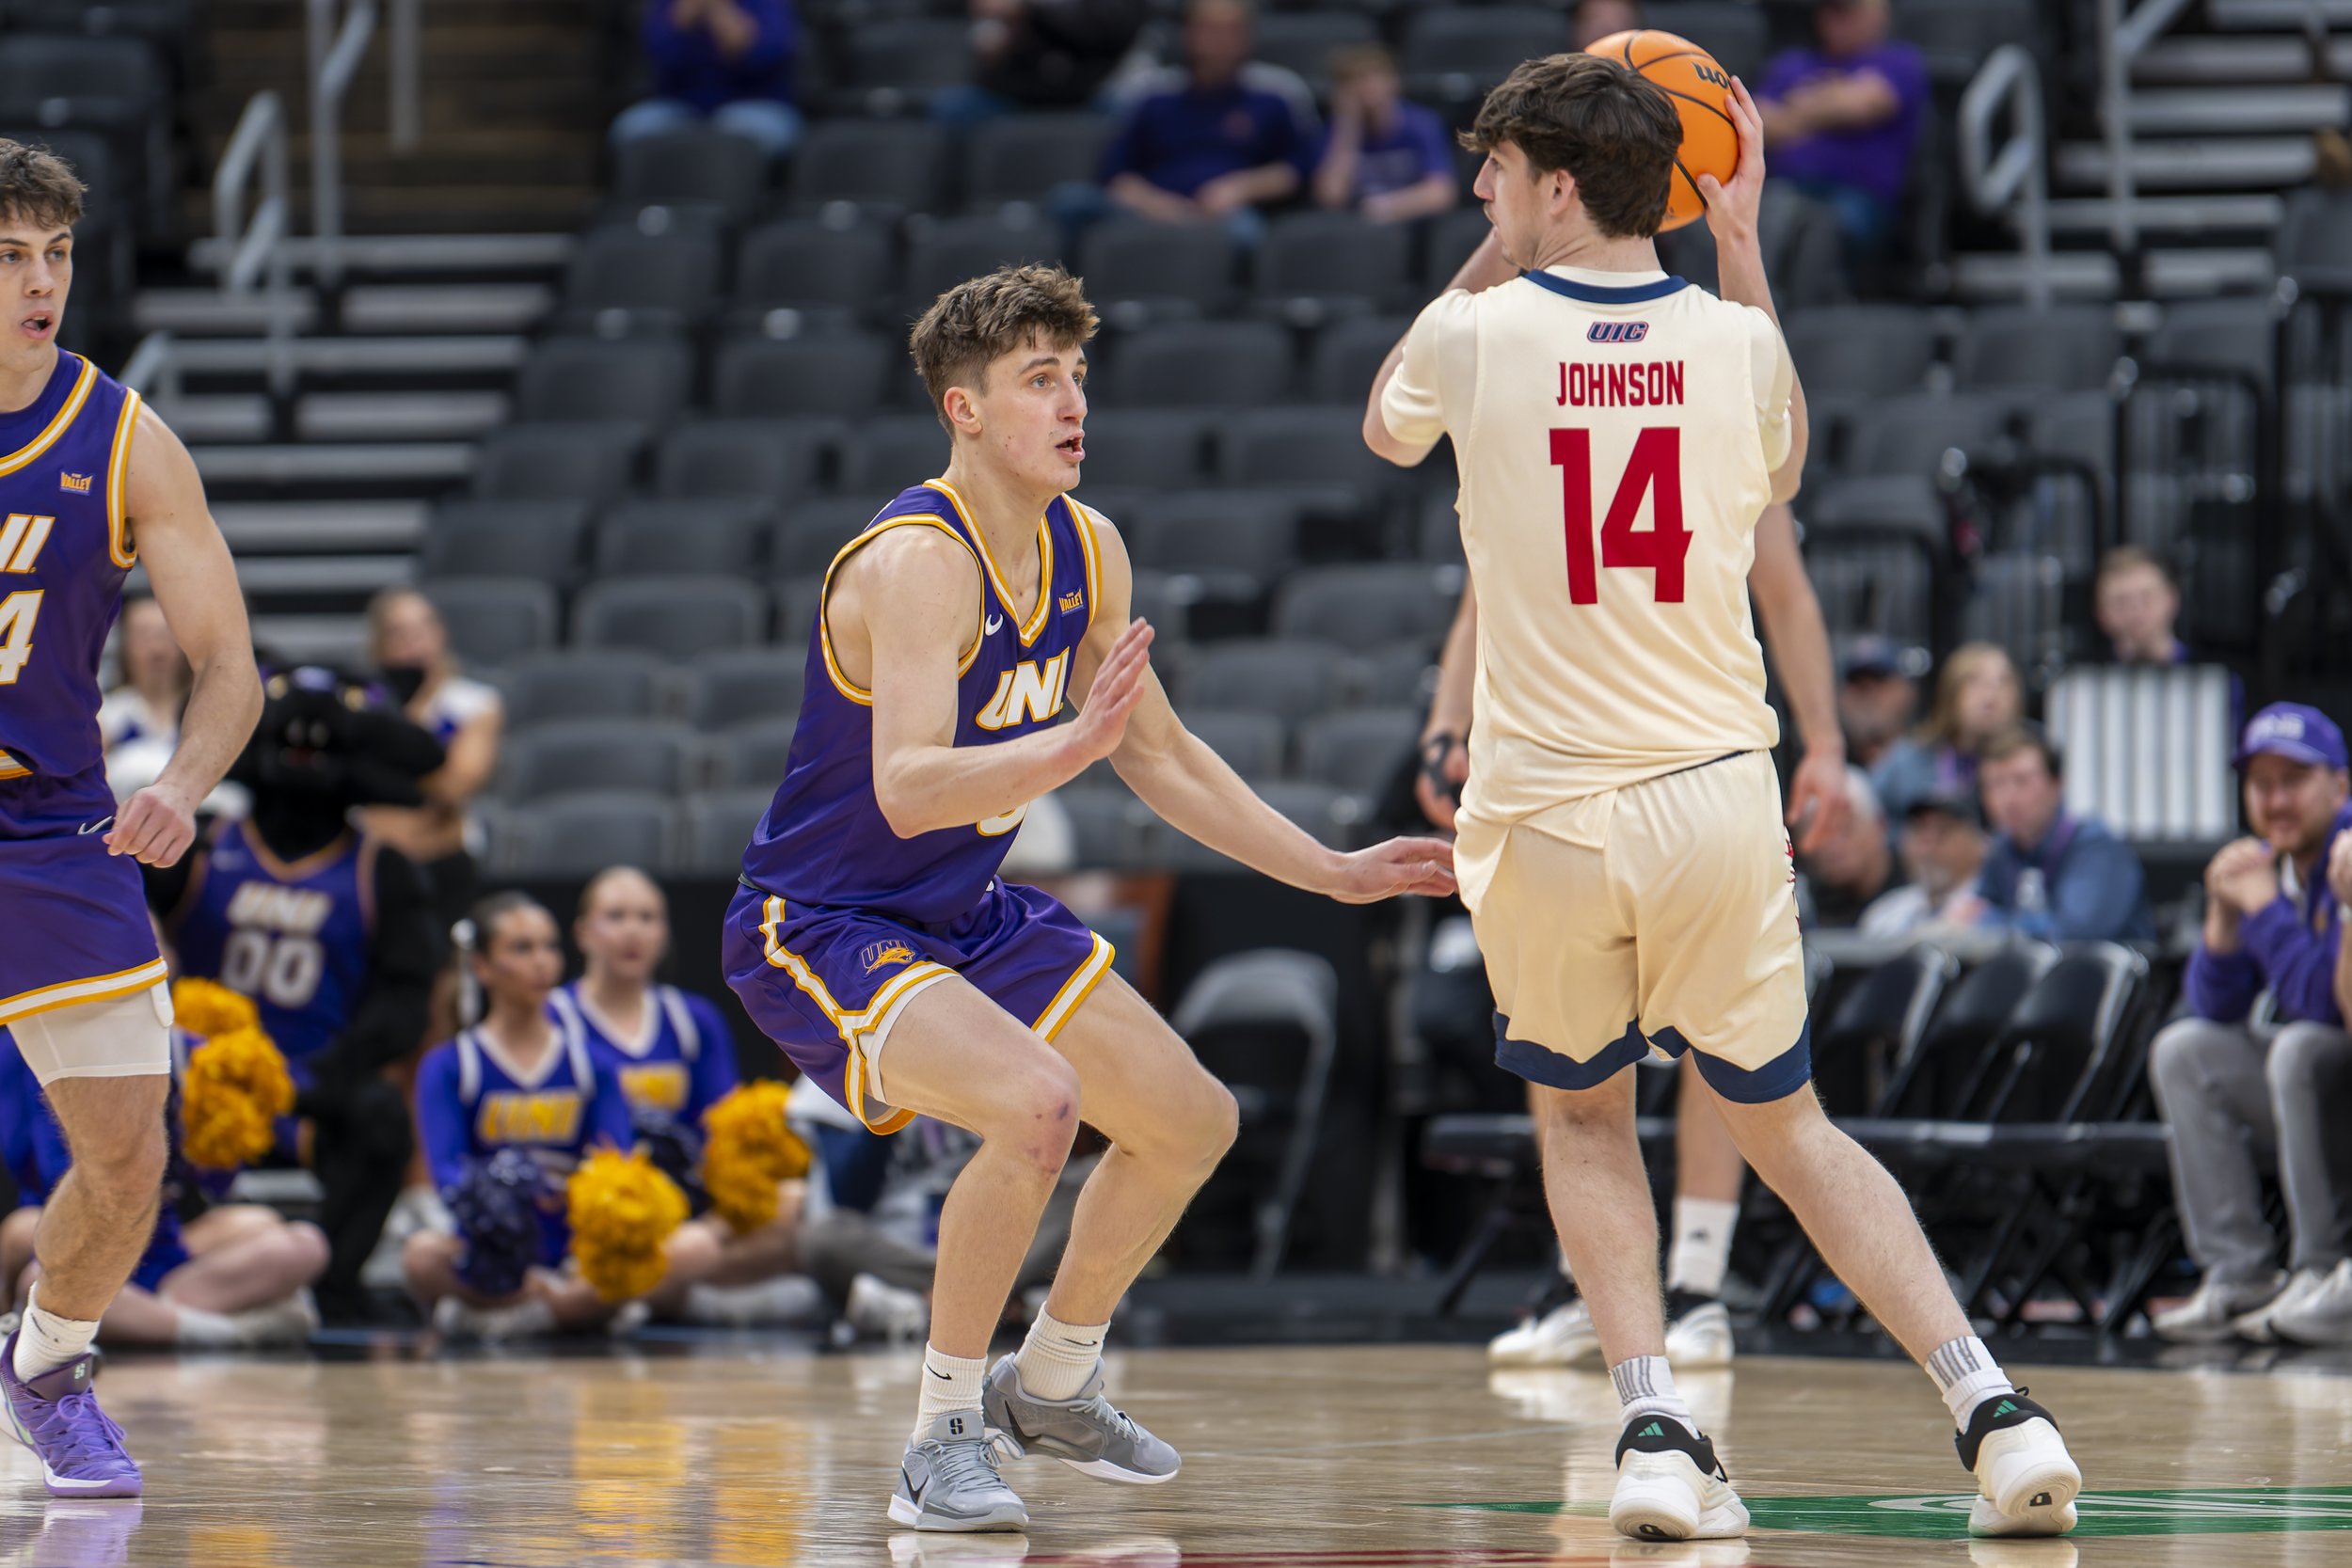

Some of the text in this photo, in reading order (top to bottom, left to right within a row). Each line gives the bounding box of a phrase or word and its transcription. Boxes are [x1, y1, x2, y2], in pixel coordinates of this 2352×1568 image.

[1587, 322, 1649, 342] UIC
[1556, 360, 1684, 406] JOHNSON
[1549, 427, 1693, 604] 14
[1058, 588, 1083, 612] VALLEY
[976, 646, 1070, 731] UNI
[223, 932, 323, 1008] 00
